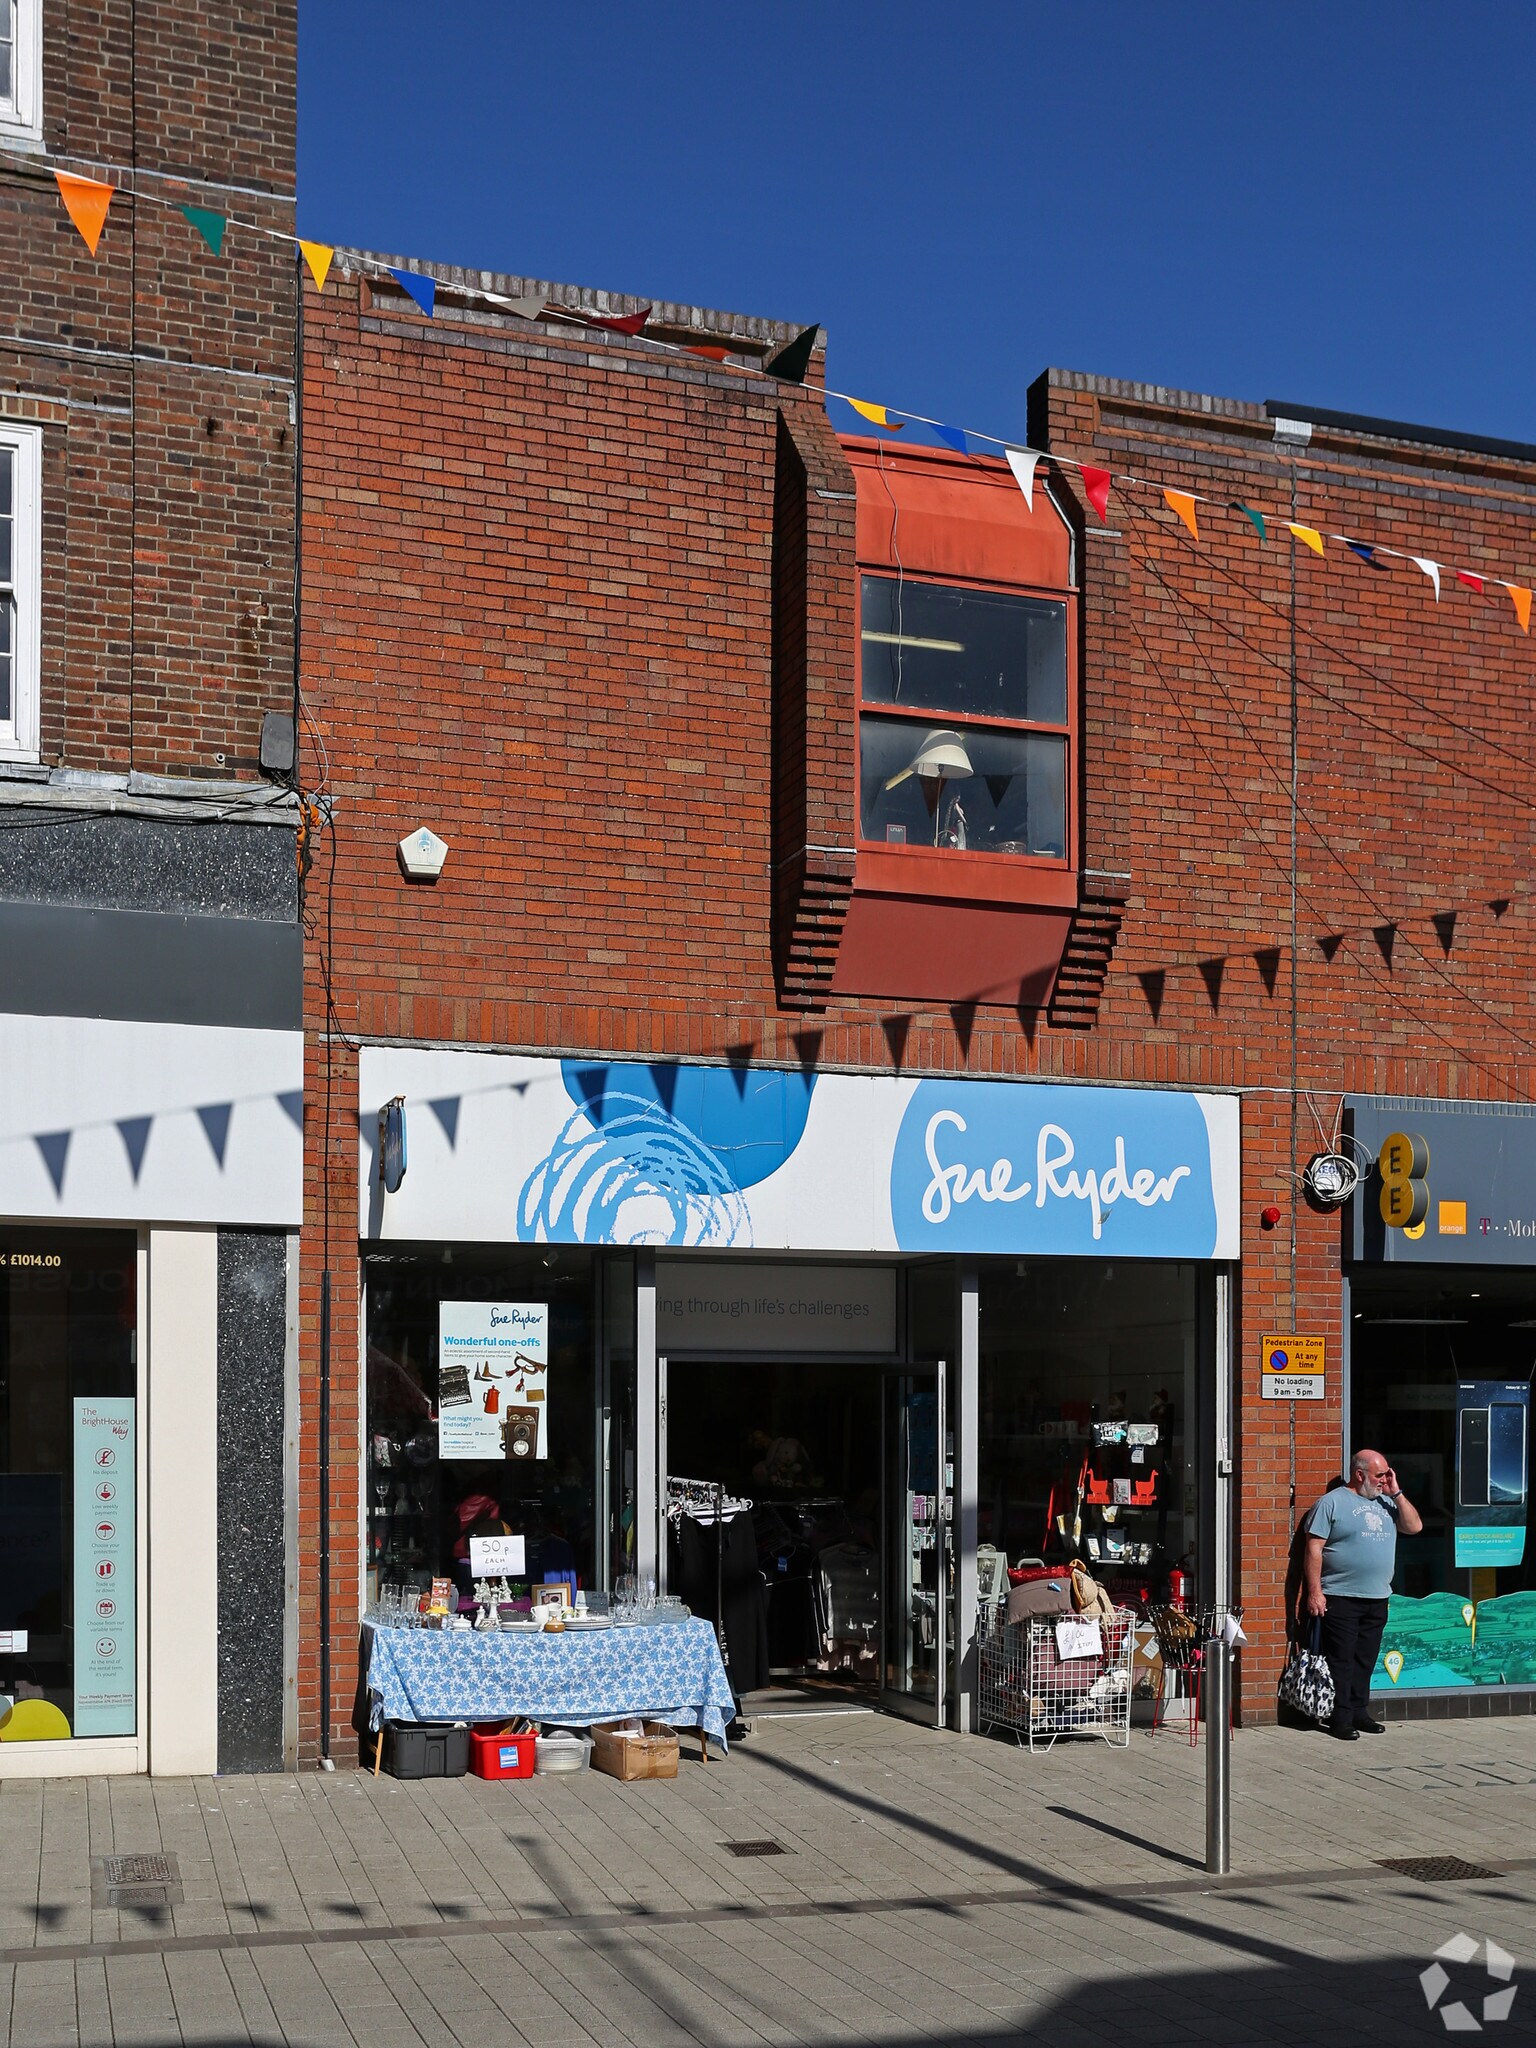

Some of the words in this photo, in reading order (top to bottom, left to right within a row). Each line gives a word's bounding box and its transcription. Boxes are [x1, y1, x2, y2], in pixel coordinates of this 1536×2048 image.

[921, 1110, 1031, 1223] Sue
[1036, 1123, 1191, 1240] Ryder
[1440, 1225, 1463, 1234] orange
[10, 1254, 61, 1267] £1014.00
[688, 1298, 750, 1318] through
[789, 1300, 870, 1320] challenges
[490, 1307, 511, 1328] Sue
[512, 1309, 544, 1330] Ryder
[444, 1336, 497, 1346] Wonderful
[498, 1337, 541, 1347] one-offs
[1265, 1338, 1304, 1346] Pedestrian
[1305, 1339, 1323, 1347] Zone
[1287, 1378, 1313, 1386] loading
[82, 1407, 97, 1416] The
[82, 1417, 129, 1427] BrightHouse
[112, 1426, 129, 1440] Way
